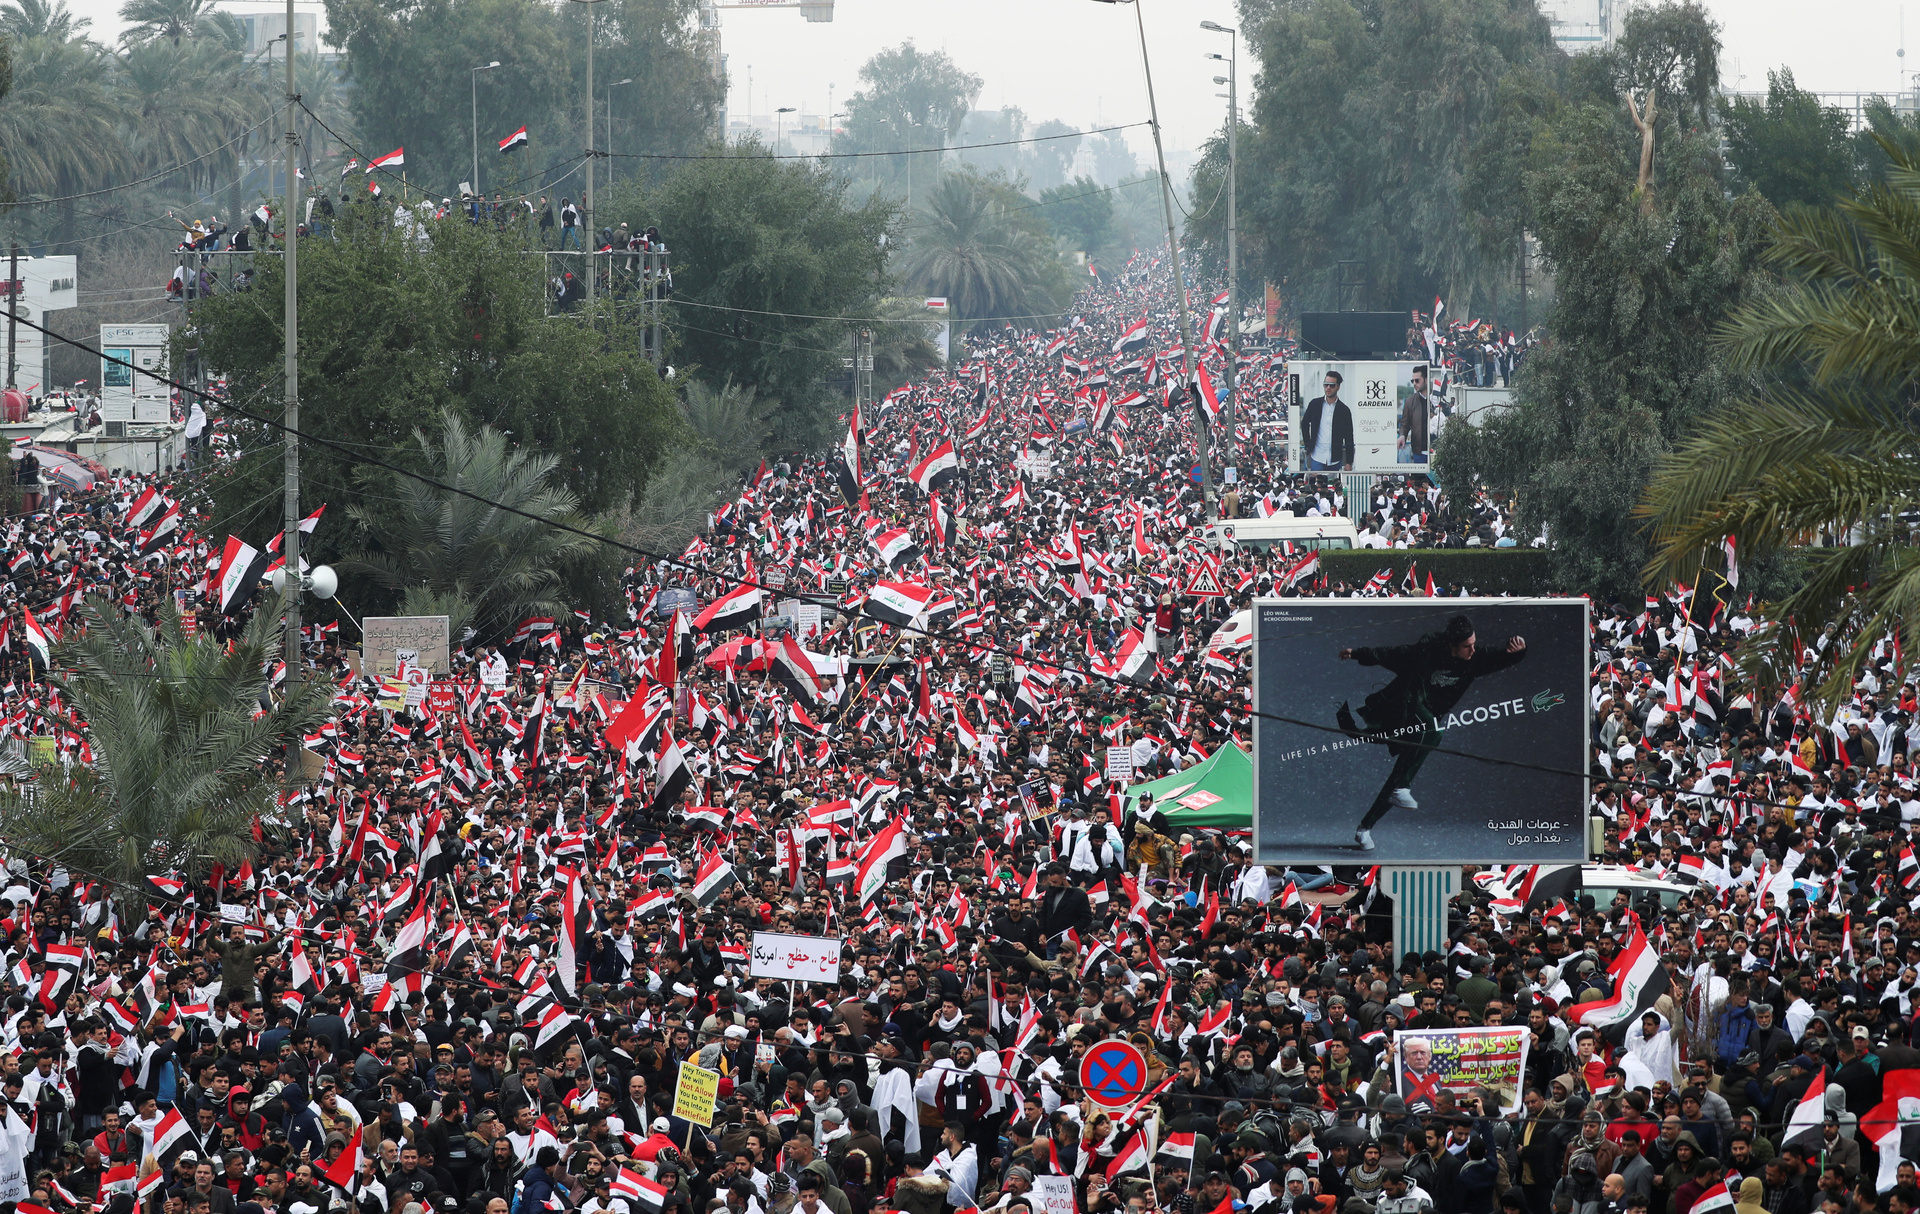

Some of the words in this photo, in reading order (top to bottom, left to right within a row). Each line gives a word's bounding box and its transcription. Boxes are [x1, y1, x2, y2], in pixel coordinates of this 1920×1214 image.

[432, 697, 454, 708] امريكا
[1433, 698, 1526, 733] LACOSTE
[1281, 749, 1302, 762] LIFE
[1306, 746, 1317, 756] IS
[1321, 744, 1328, 753] A
[1393, 722, 1427, 737] SPORT
[1487, 819, 1523, 832] الهندية
[1526, 818, 1560, 831] عرصات
[1507, 833, 1530, 846] مول
[1533, 832, 1561, 845] بغداد
[754, 945, 778, 965] امريكا
[819, 950, 838, 972] طاح
[1478, 1036, 1498, 1055] كلا
[1500, 1034, 1519, 1054] كلا
[682, 1072, 692, 1081] We
[692, 1077, 704, 1085] will
[683, 1064, 695, 1075] Hey
[695, 1068, 716, 1081] Trump!
[1443, 1063, 1477, 1084] شيطان
[1478, 1066, 1489, 1084] يا
[1490, 1064, 1504, 1080] كلا
[679, 1089, 691, 1098] You
[691, 1093, 698, 1101] to
[698, 1096, 712, 1106] Turn
[680, 1081, 694, 1091] Not
[694, 1086, 715, 1098] Allow
[678, 1097, 690, 1108] Iraq
[690, 1101, 703, 1111] into
[676, 1106, 711, 1125] Battlefield
[1044, 1184, 1057, 1196] Hey
[1057, 1184, 1069, 1194] US!
[1047, 1197, 1060, 1209] Get
[1059, 1198, 1074, 1209] Out
